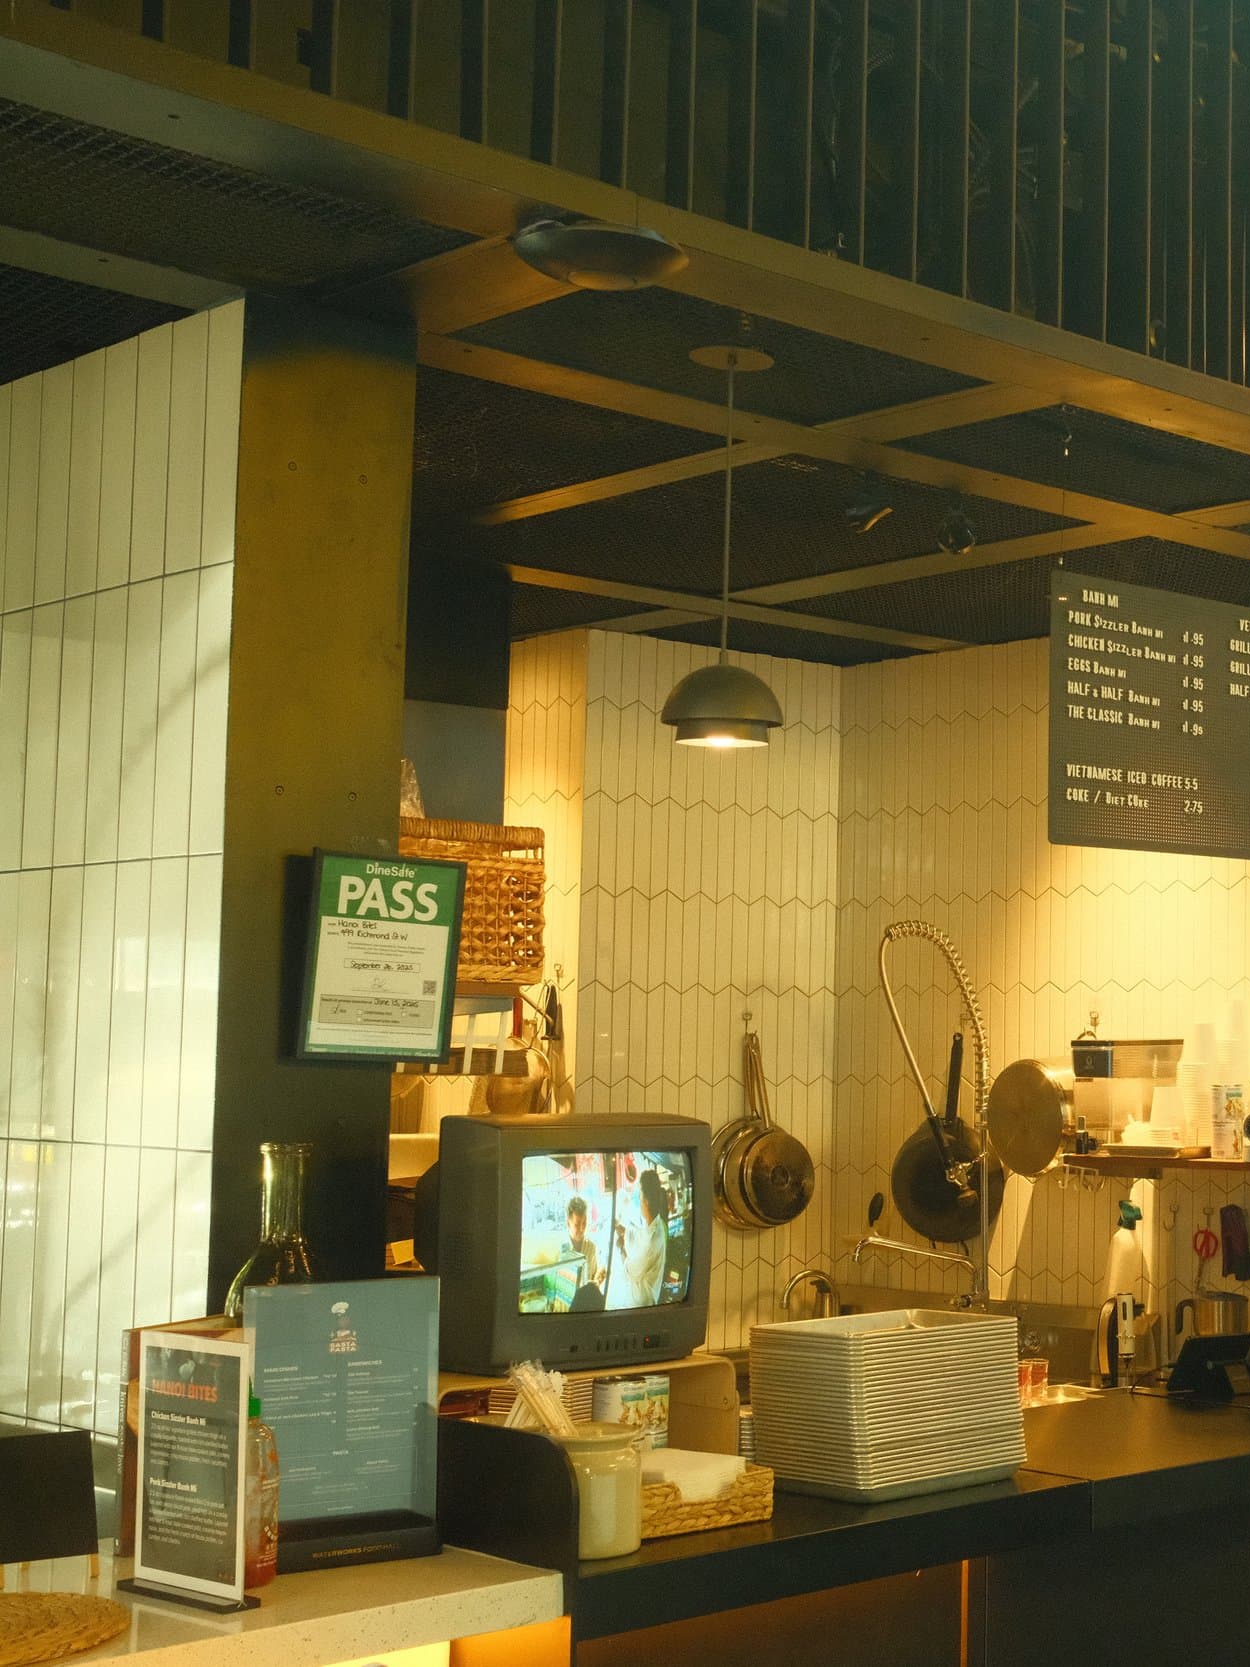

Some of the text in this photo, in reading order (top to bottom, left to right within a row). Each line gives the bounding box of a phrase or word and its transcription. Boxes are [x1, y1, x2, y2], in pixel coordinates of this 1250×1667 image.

[1083, 589, 1119, 608] BANH MI
[1068, 610, 1091, 626] PORK
[1132, 621, 1153, 637] BANH
[1068, 634, 1105, 652] CHICKEN
[1144, 646, 1166, 662] BANH
[1068, 657, 1091, 673] EGGS
[1094, 661, 1115, 675] BANH
[1067, 680, 1091, 696] HALF
[1101, 685, 1123, 701] HALF
[1128, 689, 1150, 705] BANH
[1230, 683, 1250, 697] HALF
[1067, 704, 1084, 719] THE
[1087, 707, 1123, 724] CLASSIC
[1128, 713, 1150, 728] BANH
[1066, 764, 1122, 782] VIETNAMESE
[1127, 771, 1147, 785] ICED
[1151, 773, 1183, 789] COFFEE
[1066, 788, 1089, 802] COKE
[1105, 791, 1125, 807] DIET
[1127, 794, 1150, 808] COKE
[366, 862, 416, 879] DineSafe
[337, 875, 439, 922] PASS
